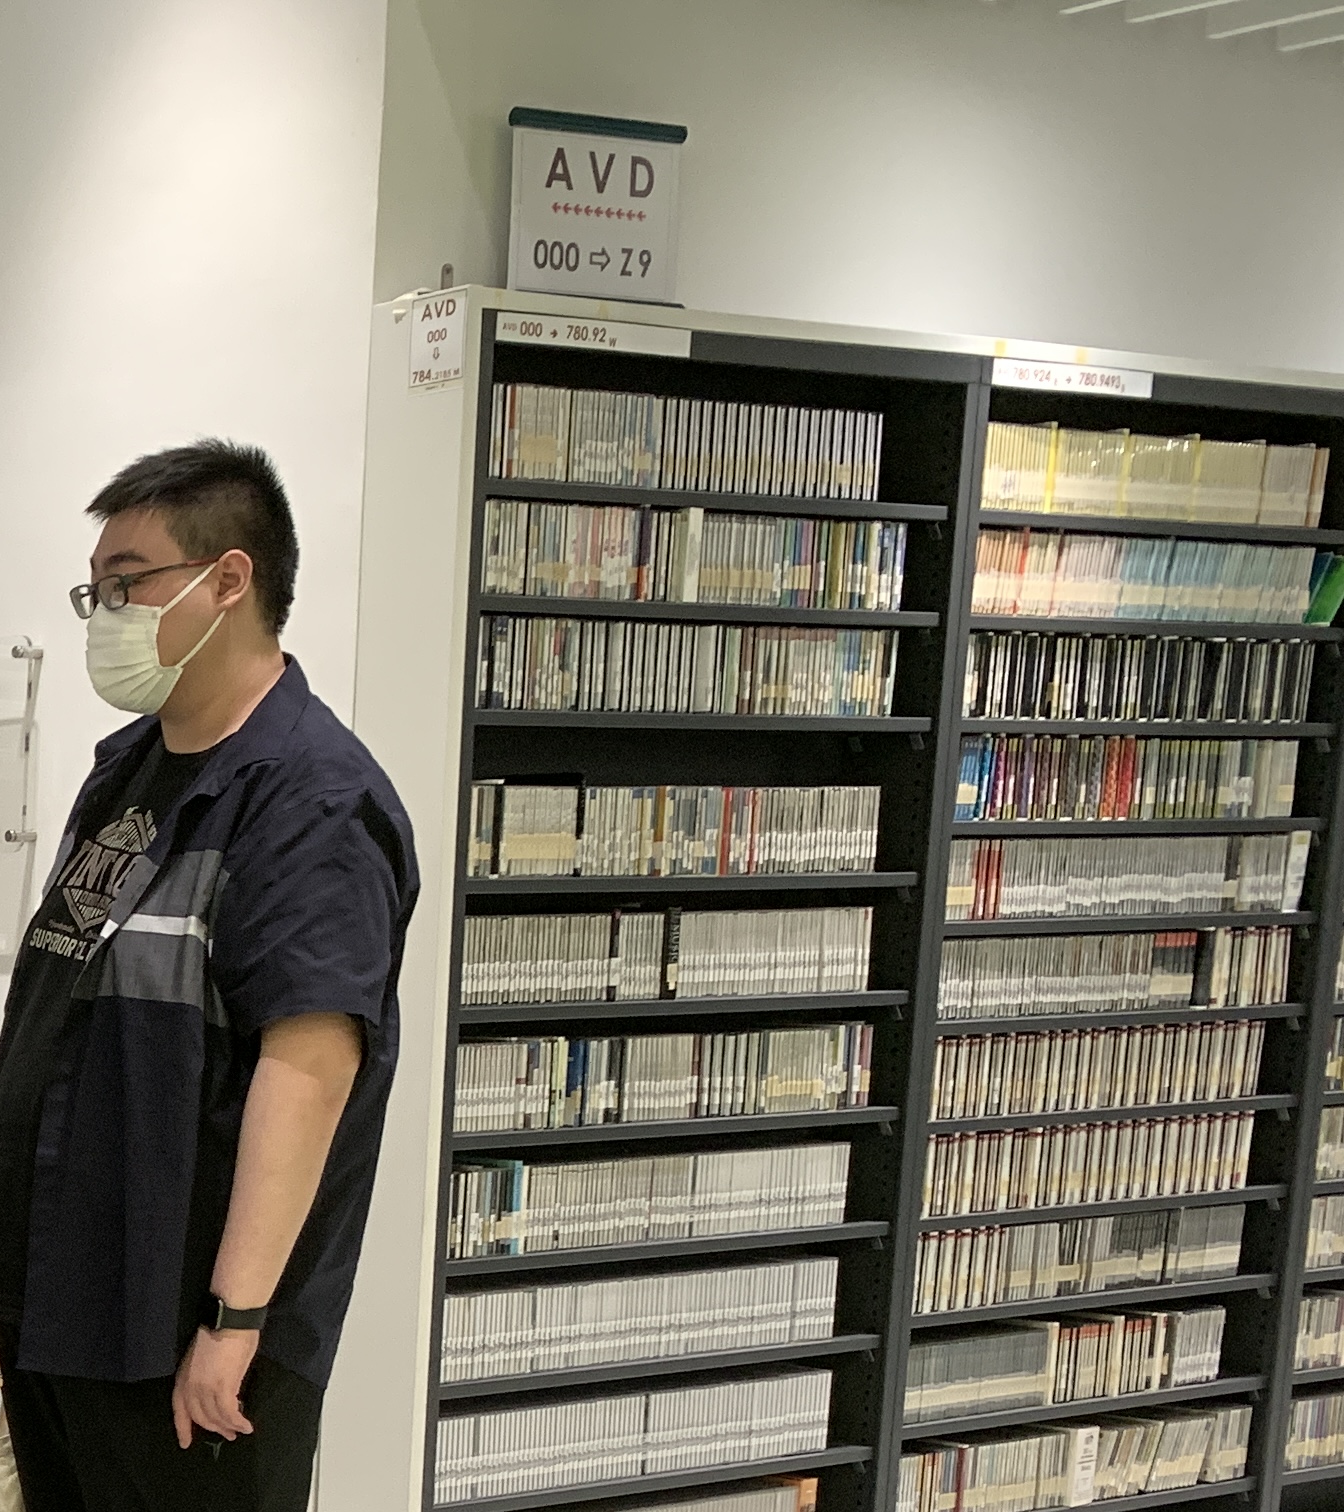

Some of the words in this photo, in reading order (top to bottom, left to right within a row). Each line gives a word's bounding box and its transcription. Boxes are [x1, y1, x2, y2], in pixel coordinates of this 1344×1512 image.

[545, 147, 655, 199] AVD
[533, 239, 580, 272] 000
[620, 247, 652, 279] Z9
[421, 298, 457, 322] AVD
[427, 327, 448, 344] 000
[520, 321, 543, 338] 000
[566, 324, 607, 343] 780.92
